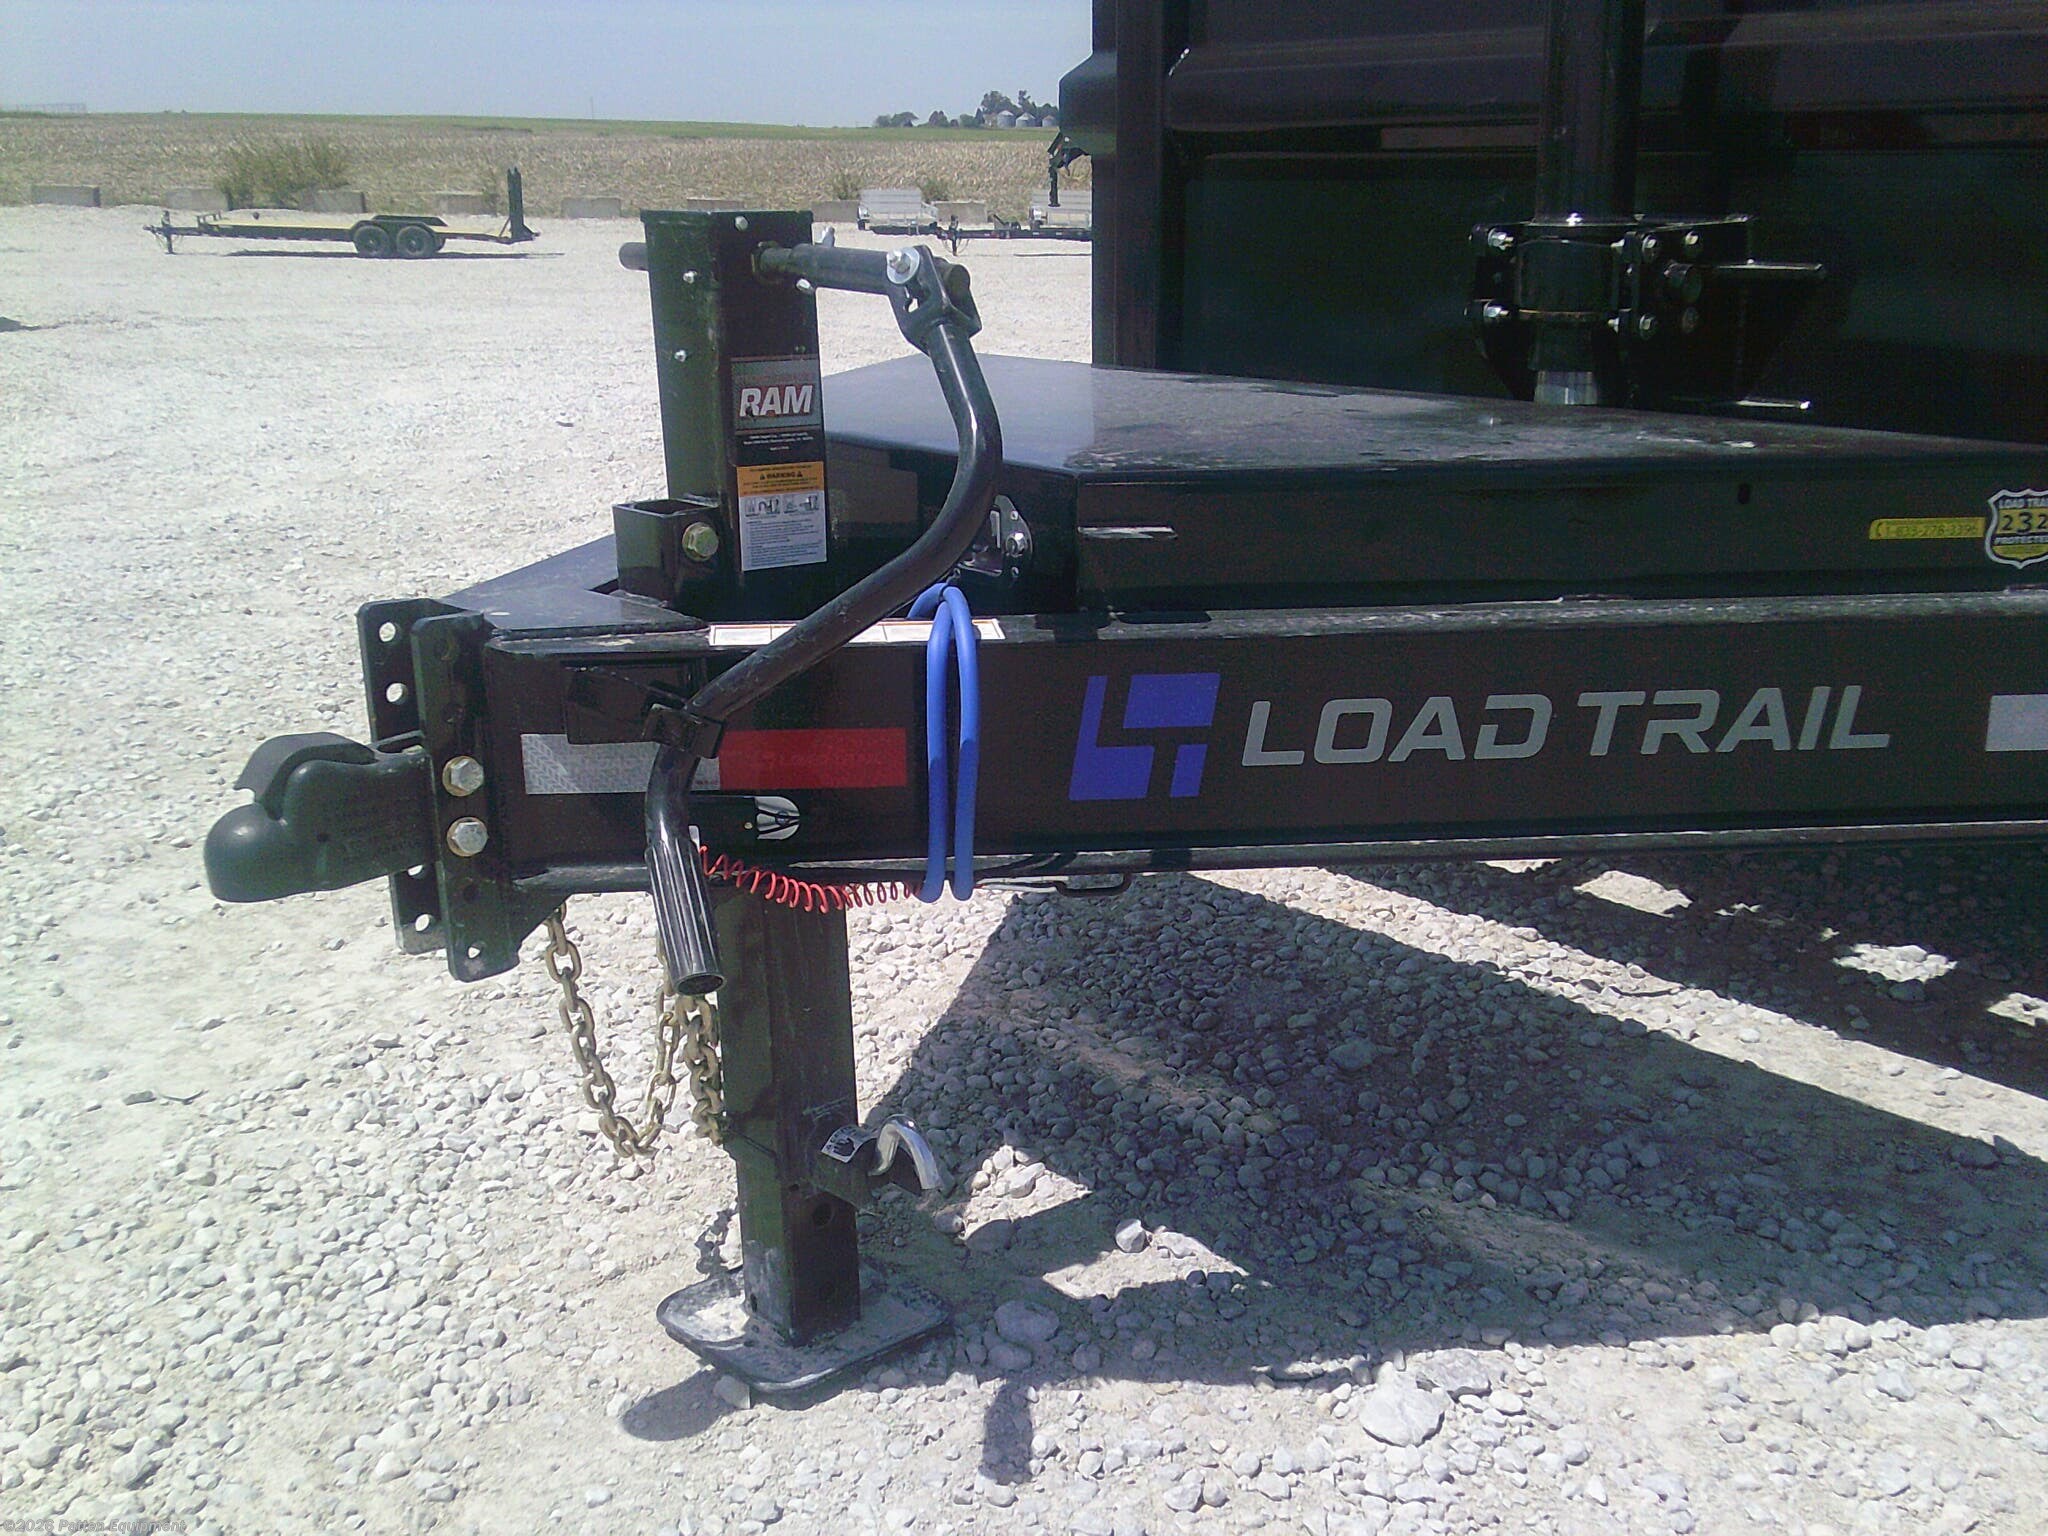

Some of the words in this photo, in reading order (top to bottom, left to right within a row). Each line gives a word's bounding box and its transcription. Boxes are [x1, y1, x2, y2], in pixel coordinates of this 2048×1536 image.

[739, 385, 813, 417] RAM
[1242, 694, 1552, 767] LOAD
[1576, 685, 1891, 757] TRAIL
